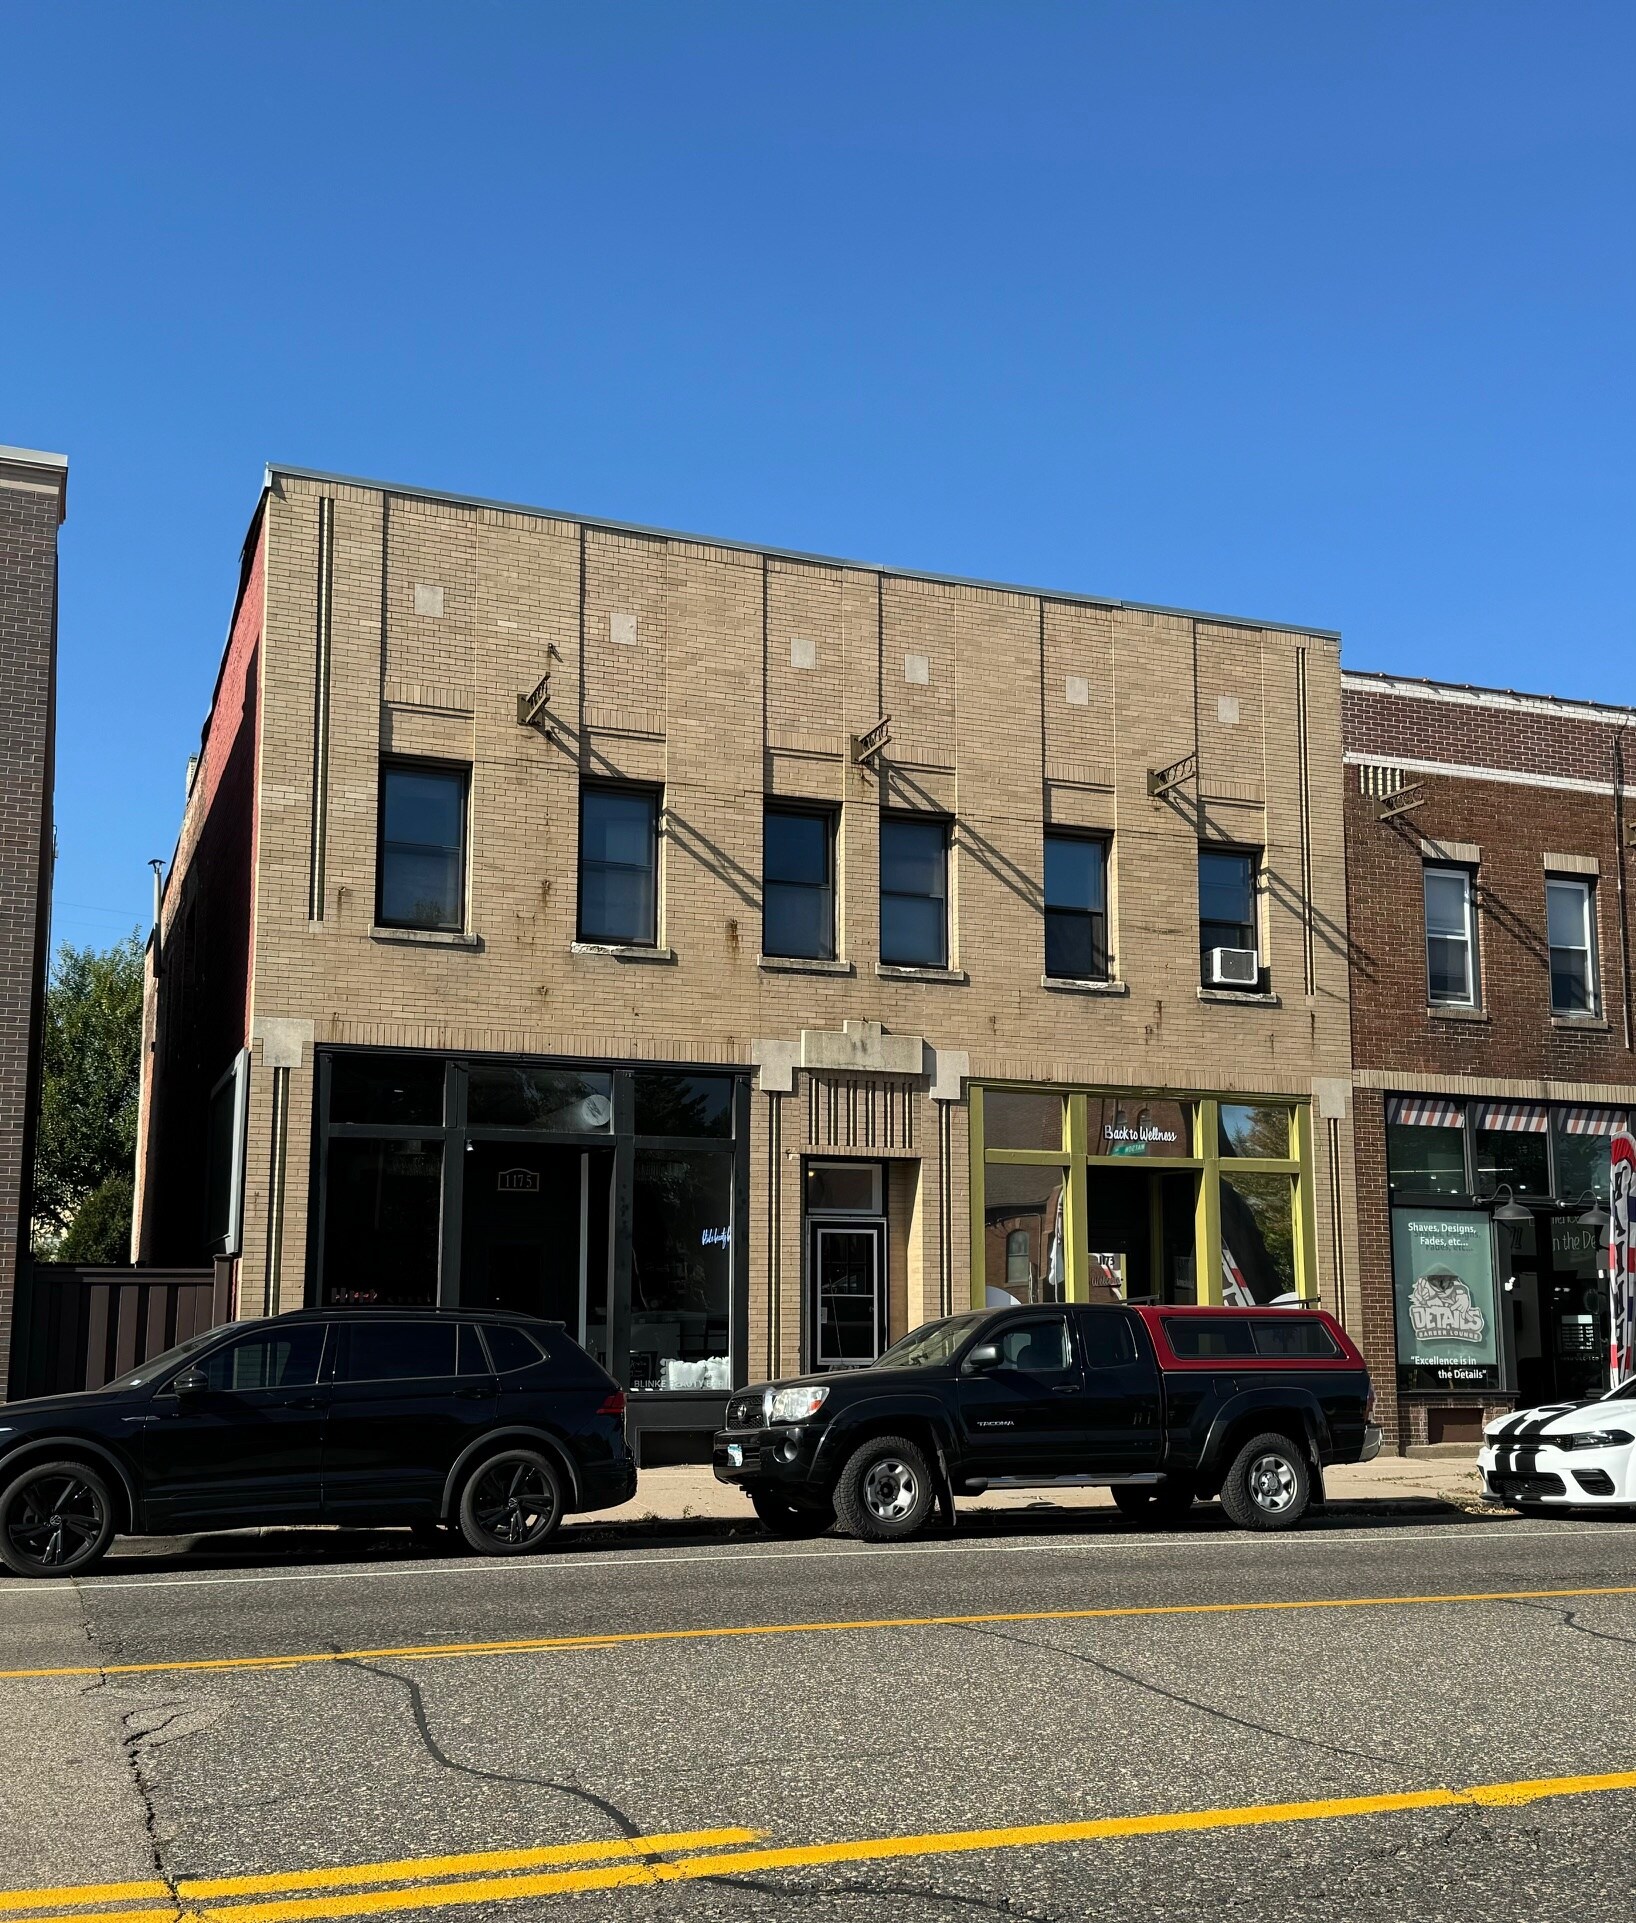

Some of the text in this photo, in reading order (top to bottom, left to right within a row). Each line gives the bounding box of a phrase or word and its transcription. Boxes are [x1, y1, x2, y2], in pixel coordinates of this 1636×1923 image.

[1104, 1124, 1178, 1142] Back to Wellness
[506, 1174, 532, 1188] 1175
[1407, 1222, 1477, 1235] Shaves, Designs,
[1420, 1236, 1447, 1247] Fades,
[1563, 1231, 1580, 1251] the
[1411, 1306, 1483, 1331] DETAILS
[1419, 1330, 1479, 1340] BARBER LOUNGE
[1460, 1356, 1467, 1365] is
[1468, 1355, 1477, 1366] in
[1438, 1368, 1487, 1379] the Details"
[634, 1379, 667, 1388] BLINKE
